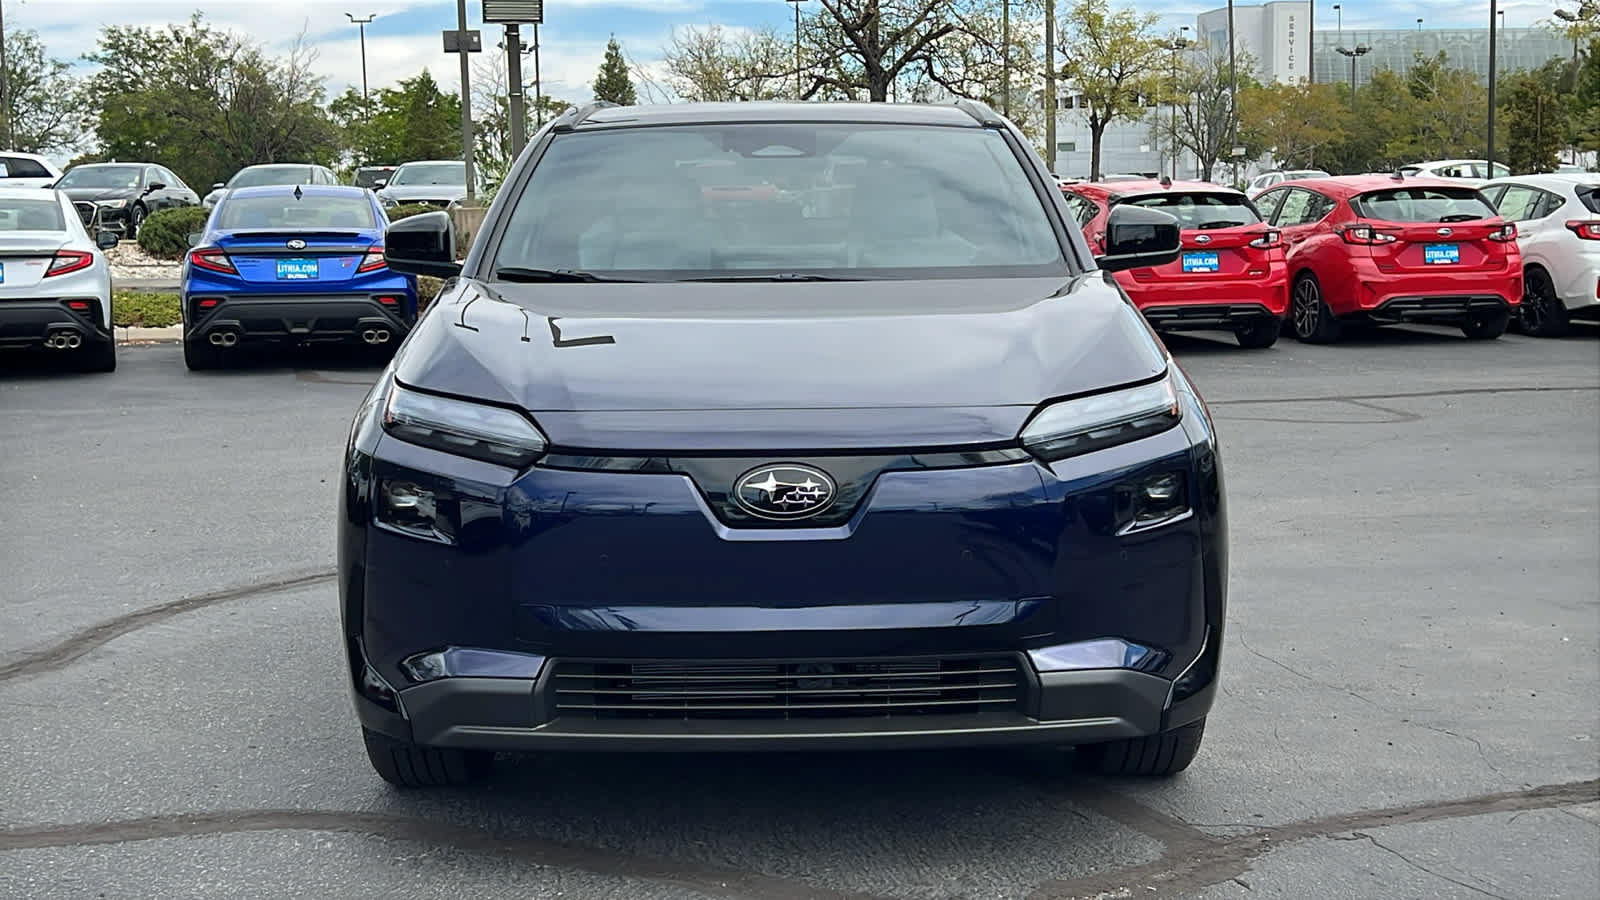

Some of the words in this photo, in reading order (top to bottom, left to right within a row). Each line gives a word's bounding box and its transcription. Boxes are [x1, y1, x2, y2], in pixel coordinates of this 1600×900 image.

[1425, 250, 1459, 259] LITHIA.COM
[1183, 257, 1219, 266] LITHIA.COM
[277, 263, 318, 273] LITHIA.COM
